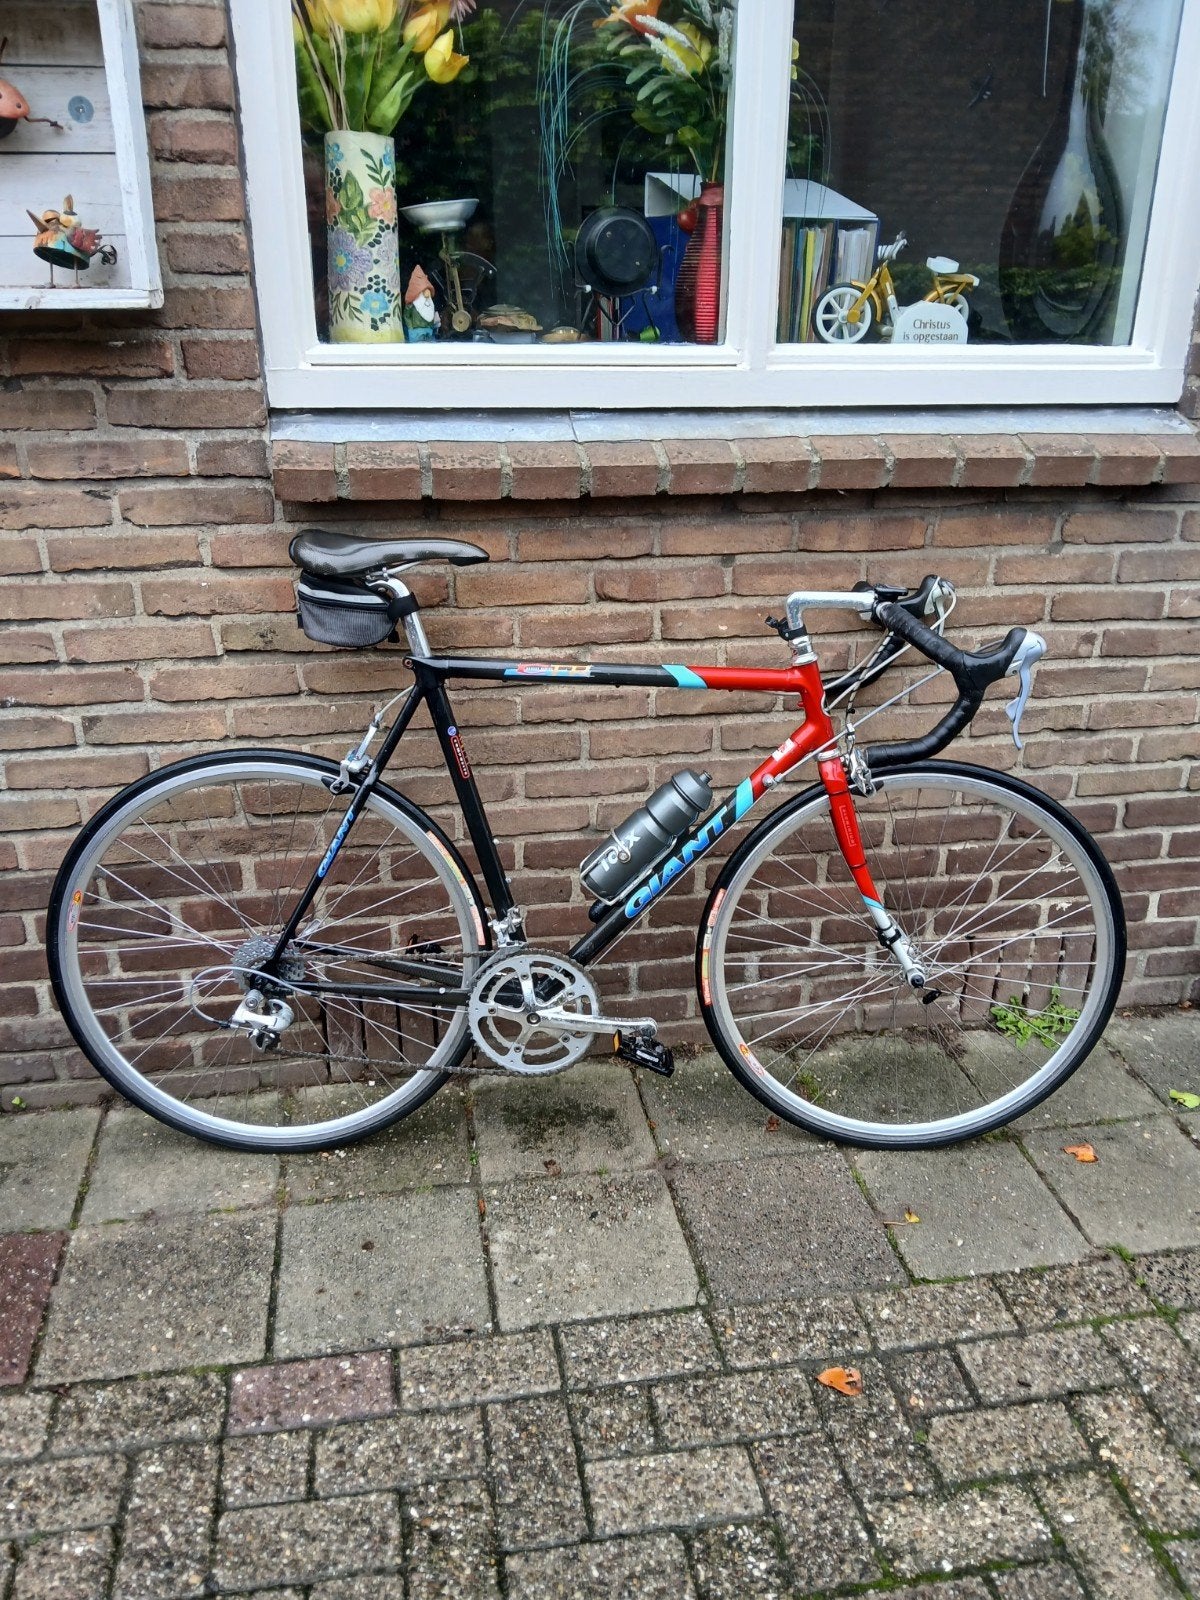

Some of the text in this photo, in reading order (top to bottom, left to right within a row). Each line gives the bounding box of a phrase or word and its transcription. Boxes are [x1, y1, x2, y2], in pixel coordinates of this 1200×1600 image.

[903, 332, 959, 343] is opgestaan
[913, 319, 951, 329] Christus
[317, 804, 354, 878] GIANT
[624, 805, 728, 919] GIANT
